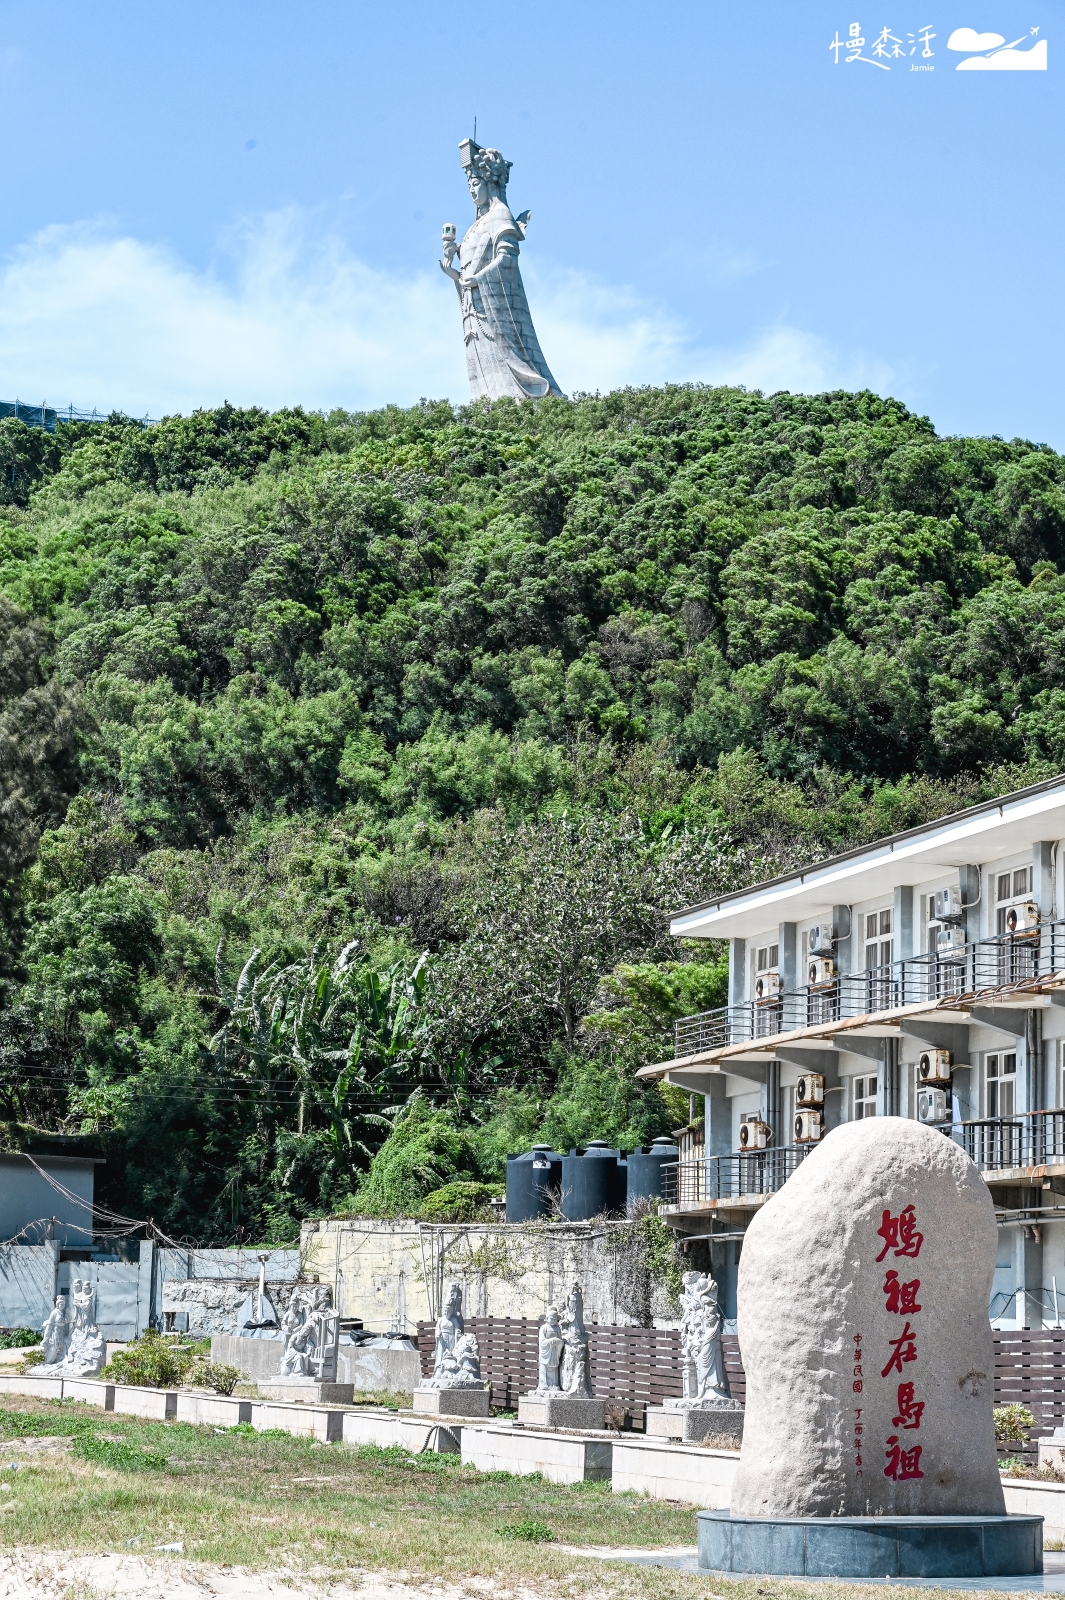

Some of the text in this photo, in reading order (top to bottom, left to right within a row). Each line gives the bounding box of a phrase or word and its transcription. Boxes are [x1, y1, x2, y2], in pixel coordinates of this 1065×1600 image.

[853, 1332, 863, 1394] 中華民國
[875, 1204, 925, 1481] 媽祖在馬祖
